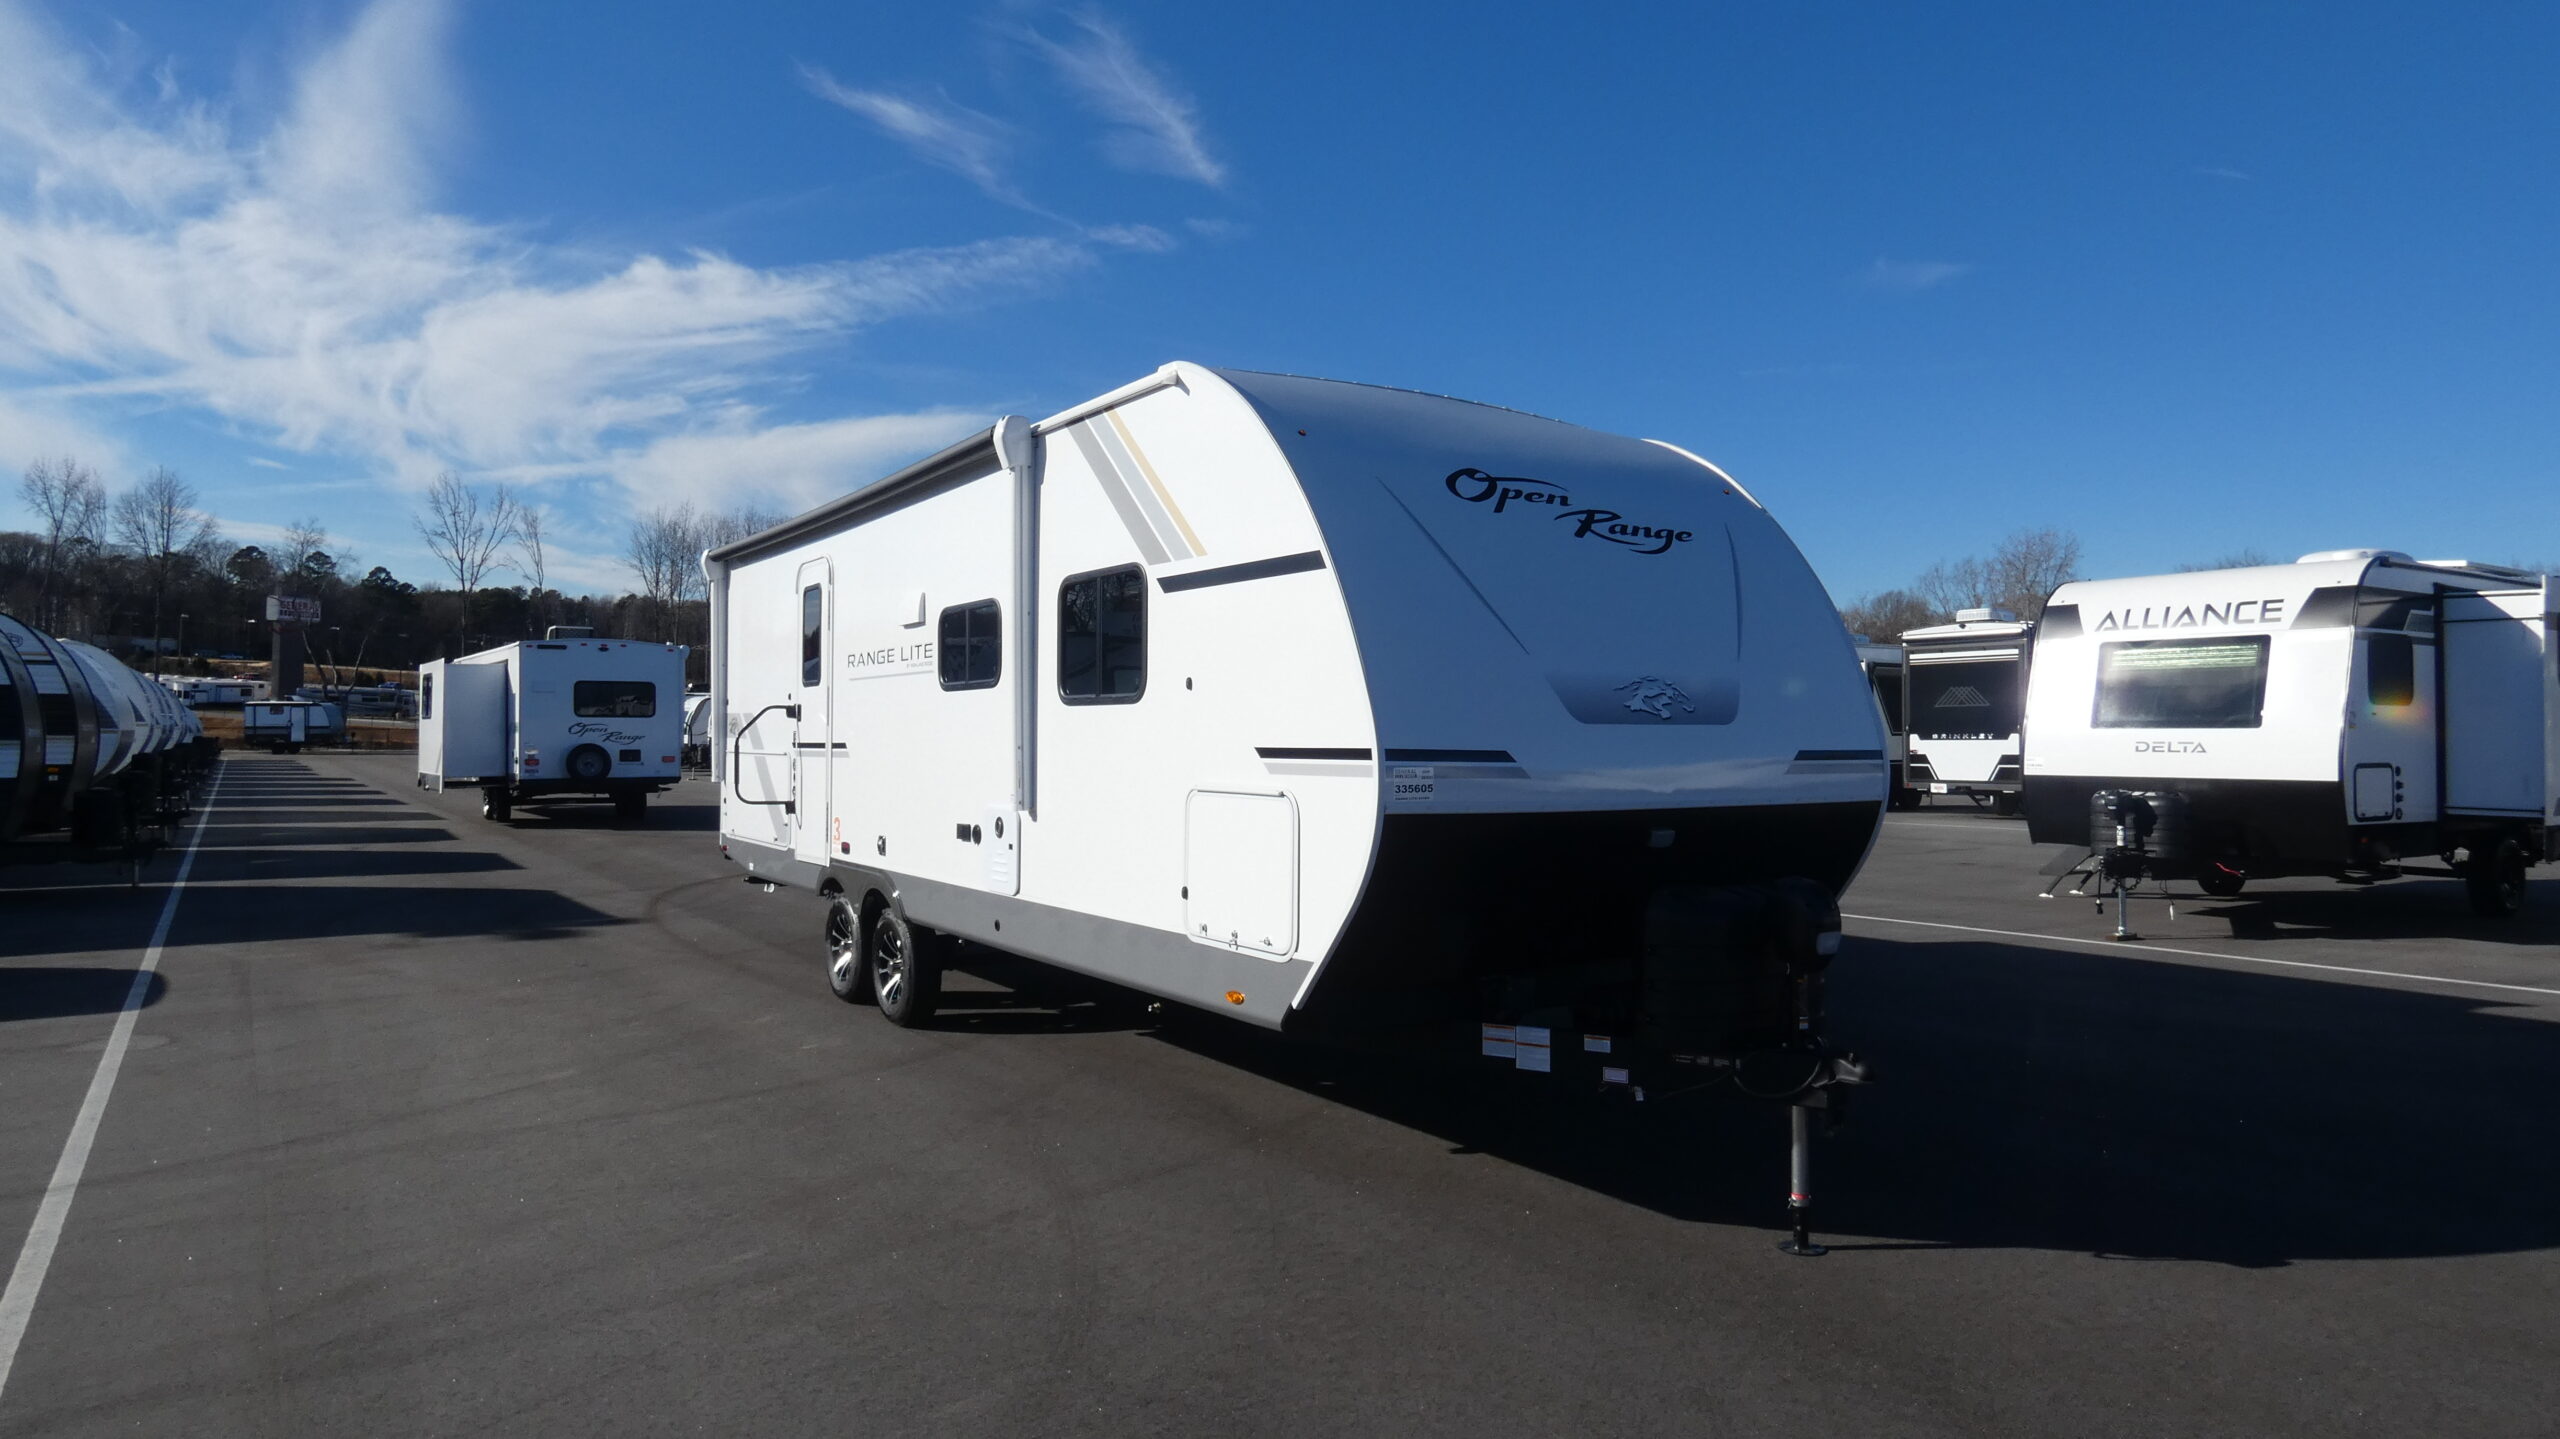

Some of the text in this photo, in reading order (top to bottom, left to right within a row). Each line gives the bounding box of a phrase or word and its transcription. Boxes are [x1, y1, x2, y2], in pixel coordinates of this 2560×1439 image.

[1445, 467, 1573, 513] Open
[1554, 509, 1694, 555] Range
[2094, 598, 2285, 632] ALLIANCE
[847, 642, 934, 668] RANGE LITE
[568, 722, 609, 737] Open
[601, 731, 647, 745] Range
[2135, 741, 2207, 753] DELTA
[1394, 783, 1434, 794] 335605
